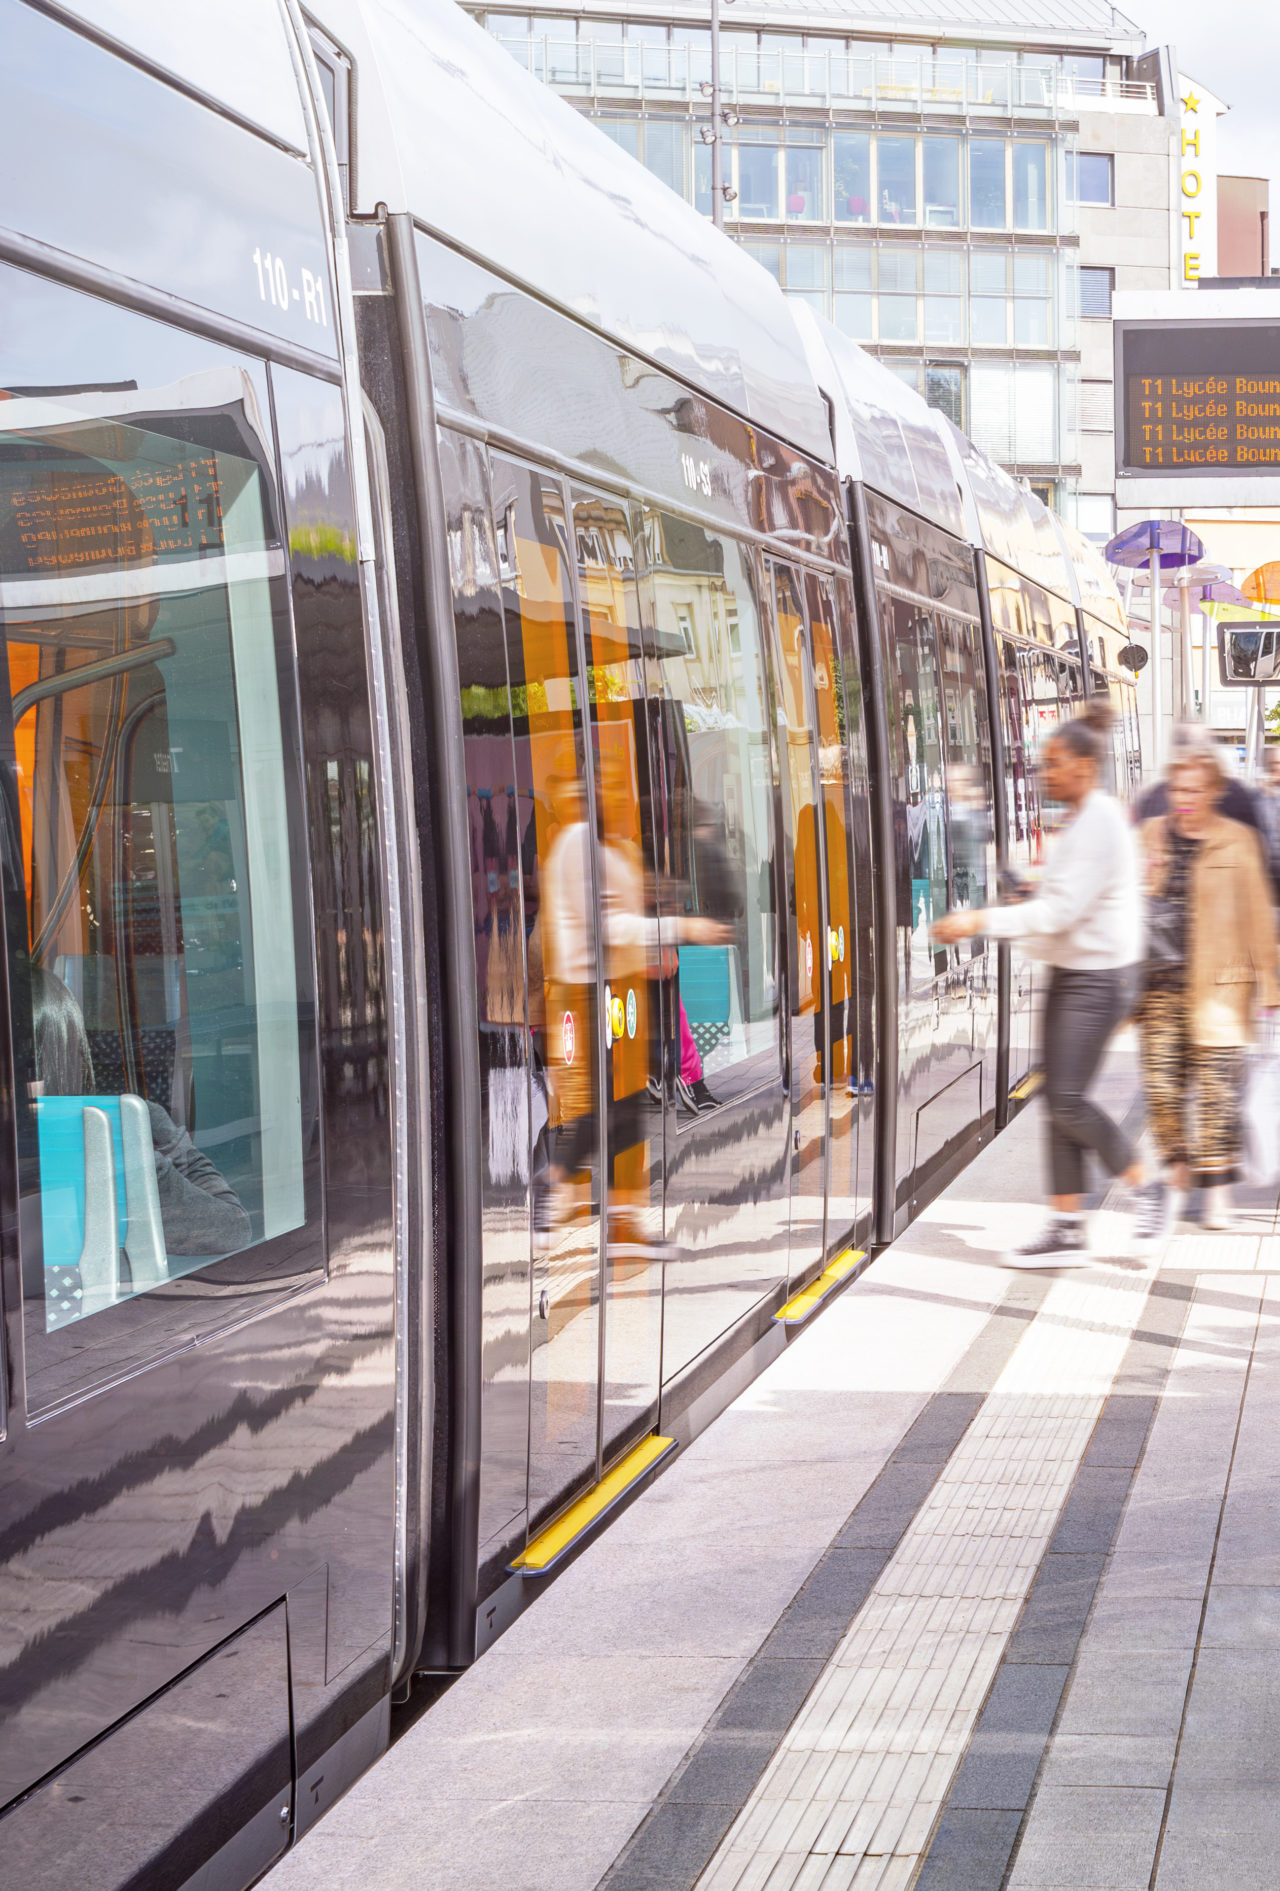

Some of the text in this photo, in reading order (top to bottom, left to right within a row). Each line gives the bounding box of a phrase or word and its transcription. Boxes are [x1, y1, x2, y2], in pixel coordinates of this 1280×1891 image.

[1141, 379, 1162, 395] T1
[1172, 377, 1228, 398] Lycée
[1141, 402, 1162, 418] T1
[1172, 400, 1228, 421] Lycée
[1142, 424, 1163, 441] T1
[1172, 422, 1228, 443] Lycée
[1142, 447, 1163, 463] T1
